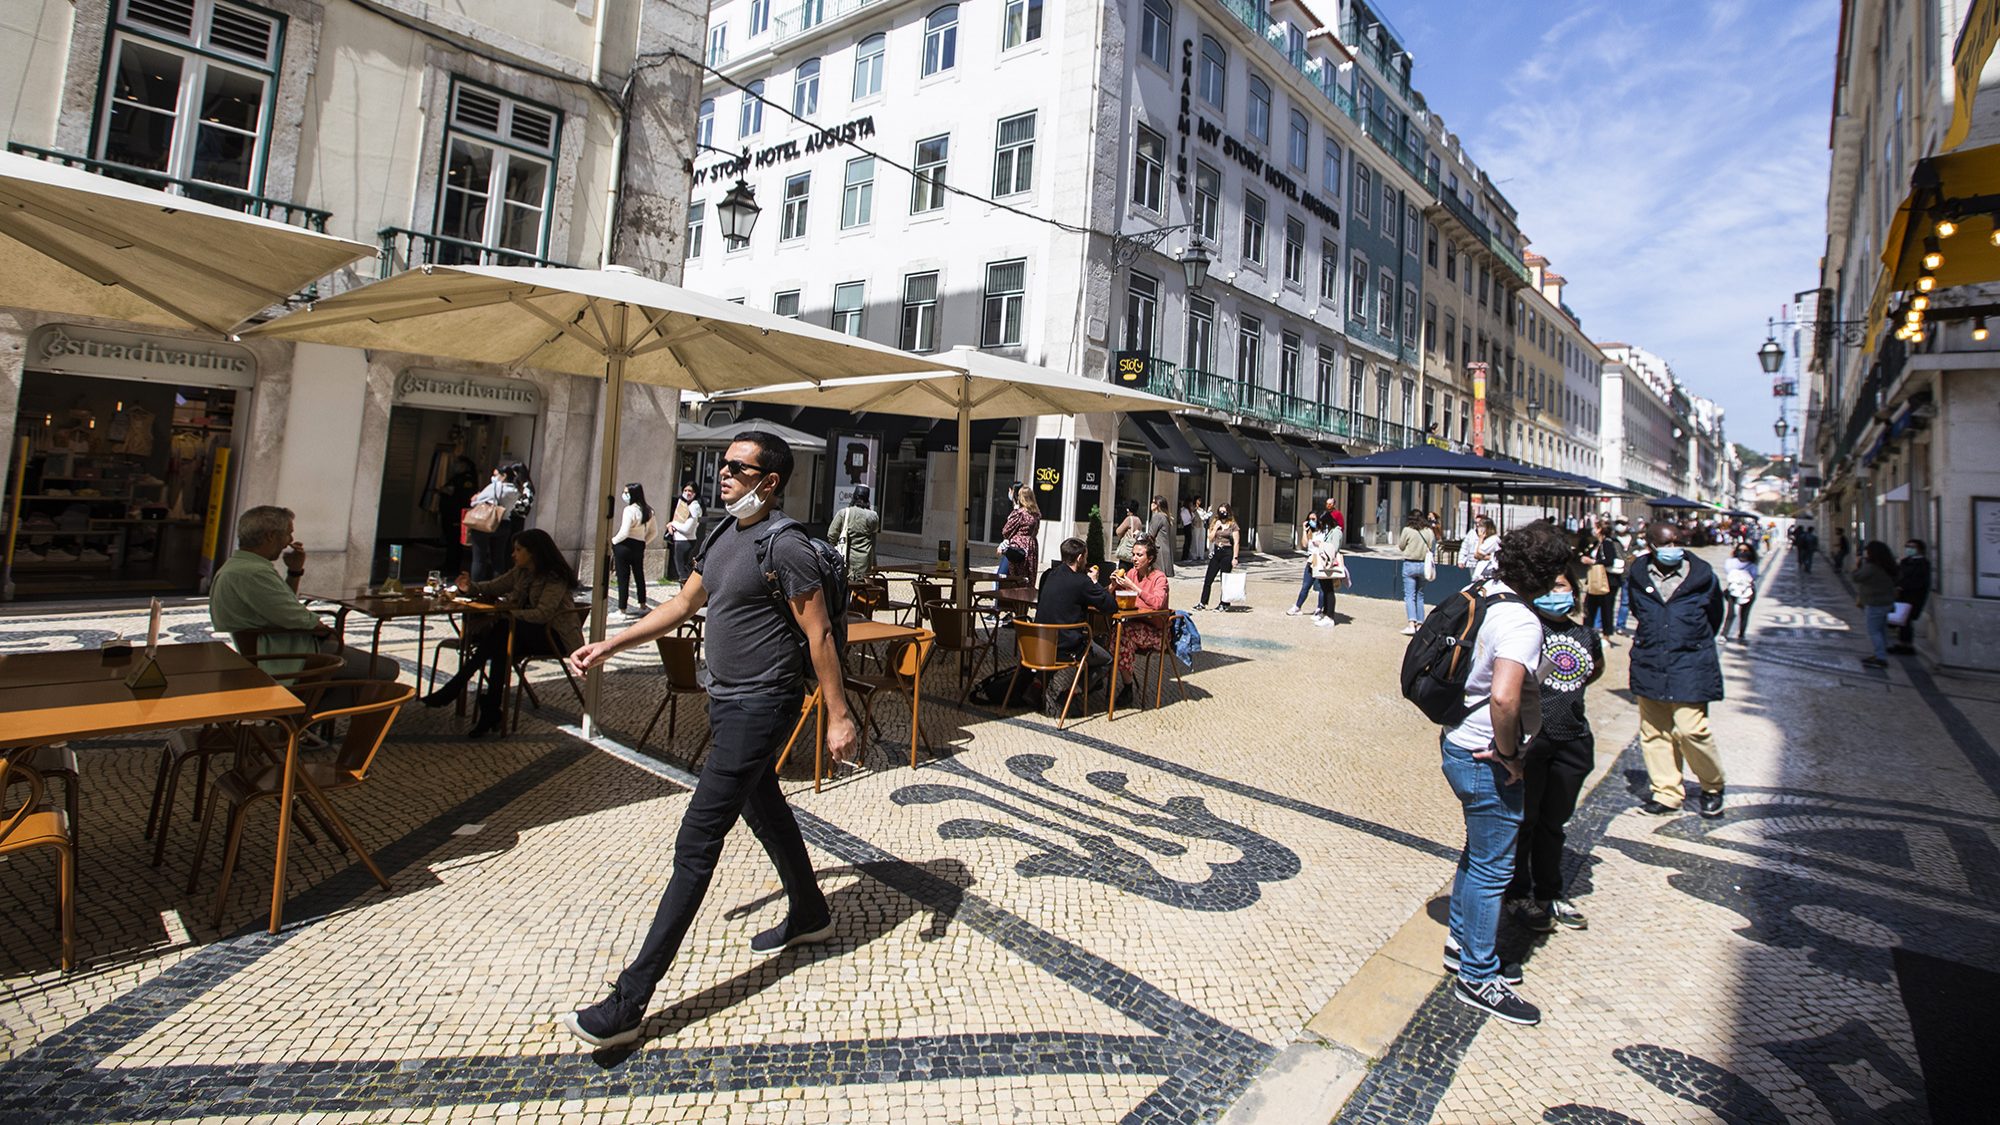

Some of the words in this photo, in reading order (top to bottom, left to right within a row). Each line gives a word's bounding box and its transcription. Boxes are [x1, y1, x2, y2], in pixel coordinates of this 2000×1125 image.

[755, 140, 801, 168] HOTEL
[805, 115, 876, 155] AUGUSTA
[1177, 38, 1193, 194] CHARMING
[1198, 116, 1221, 147] MY
[1223, 135, 1264, 175] STORY
[1265, 164, 1300, 202] HOTEL
[1301, 190, 1340, 231] AUGUSTA
